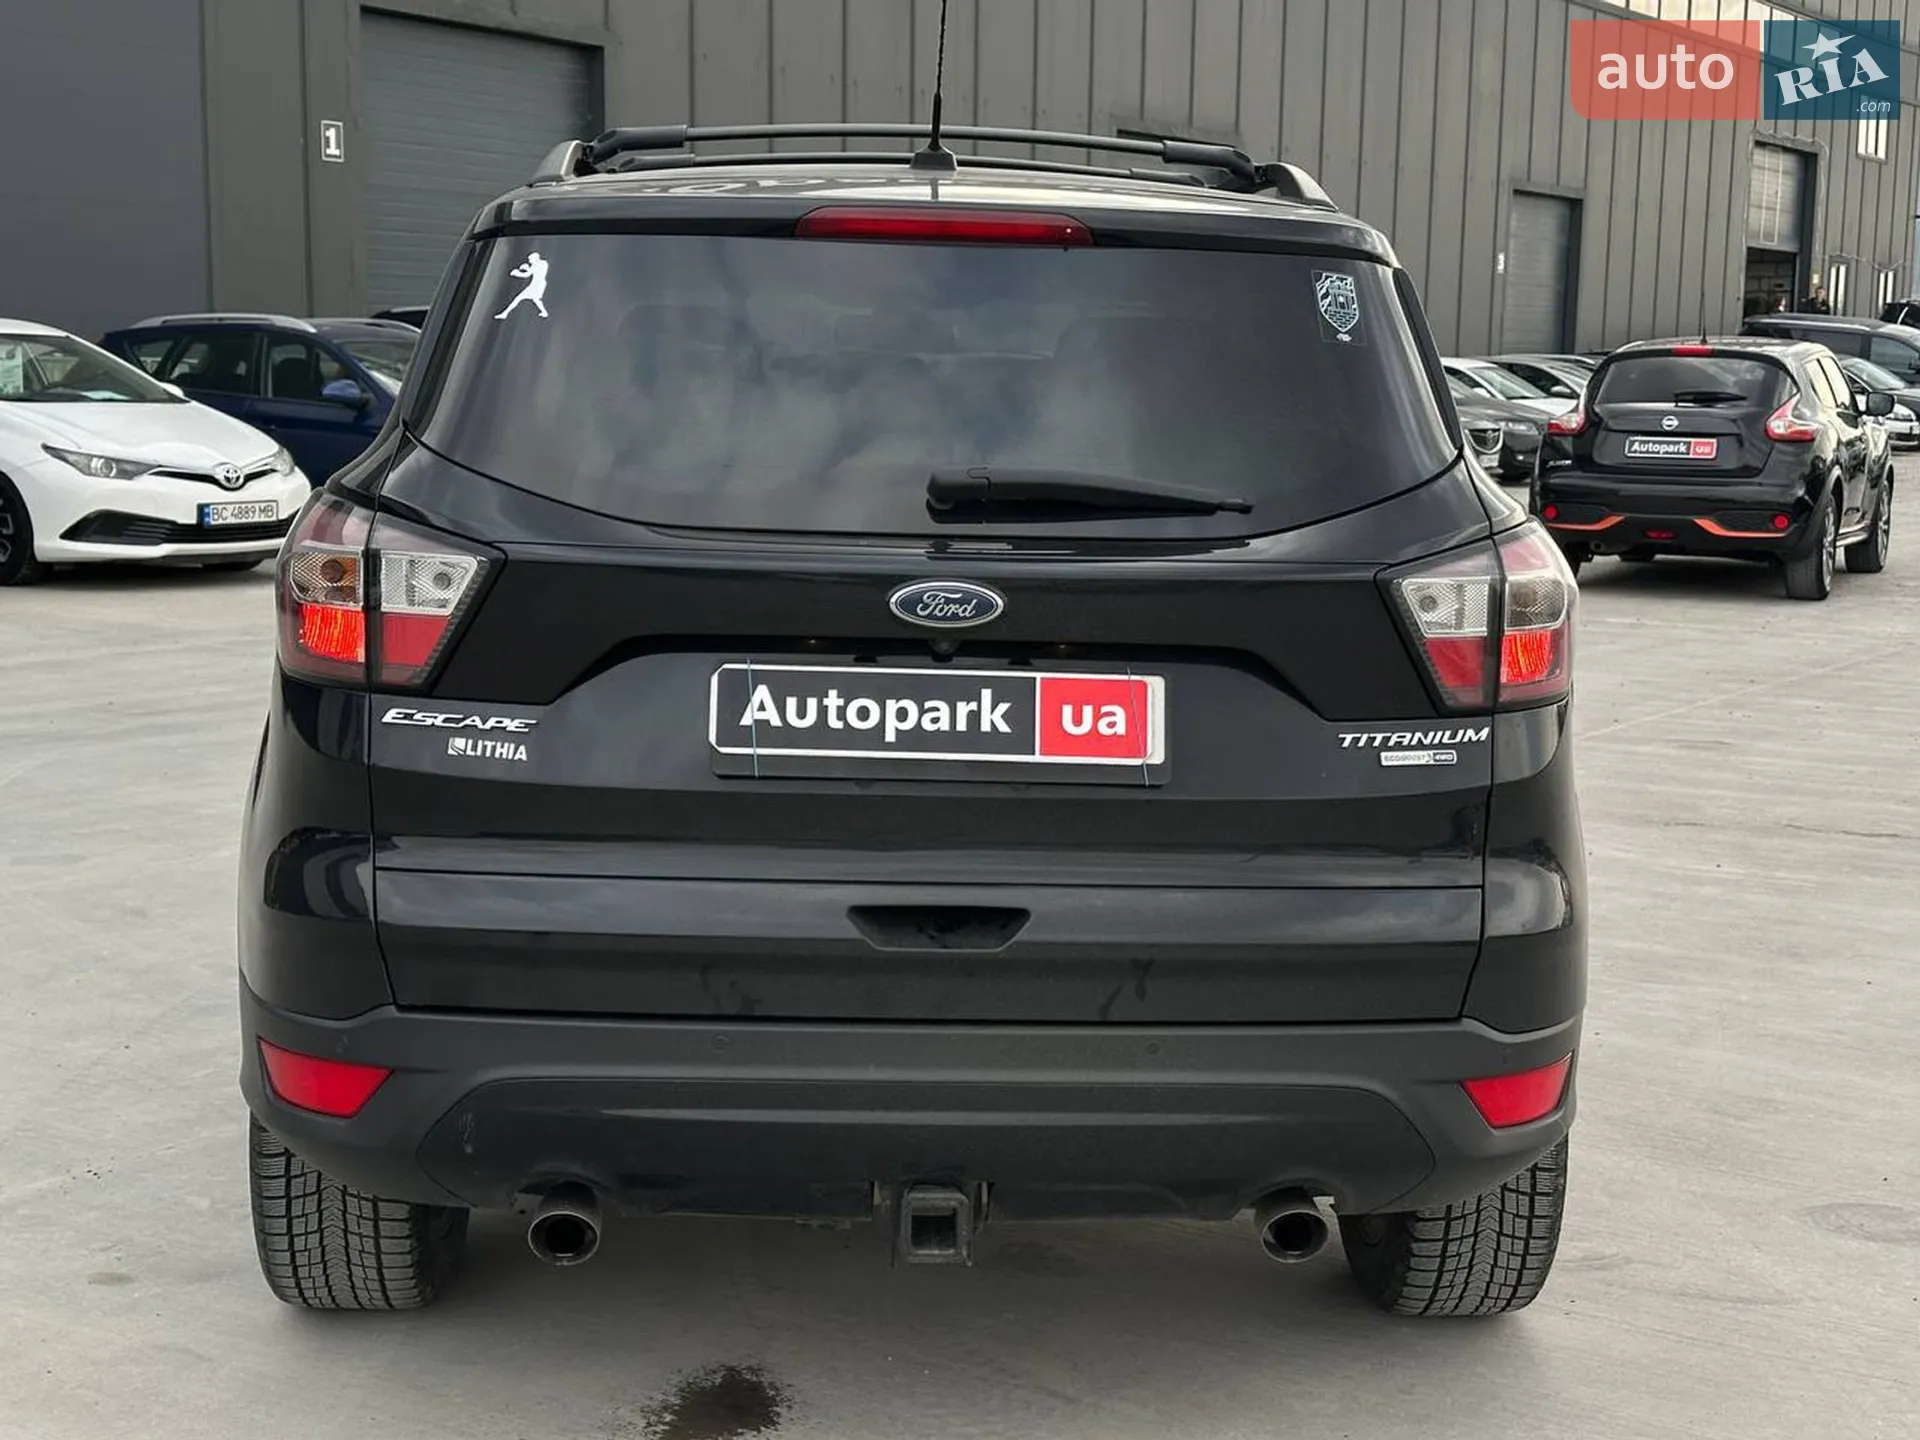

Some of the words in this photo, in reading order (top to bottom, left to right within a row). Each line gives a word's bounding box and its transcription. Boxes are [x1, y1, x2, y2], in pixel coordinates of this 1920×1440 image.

[325, 127, 340, 156] 1
[1630, 442, 1687, 455] Autopark
[211, 506, 229, 522] BC
[258, 504, 274, 519] MB
[916, 591, 977, 617] Ford
[381, 708, 538, 732] ESCAPE
[739, 684, 1012, 742] Autopark
[1060, 703, 1127, 736] ua
[1338, 727, 1490, 748] TITANIUM
[466, 738, 528, 761] LITHIA
